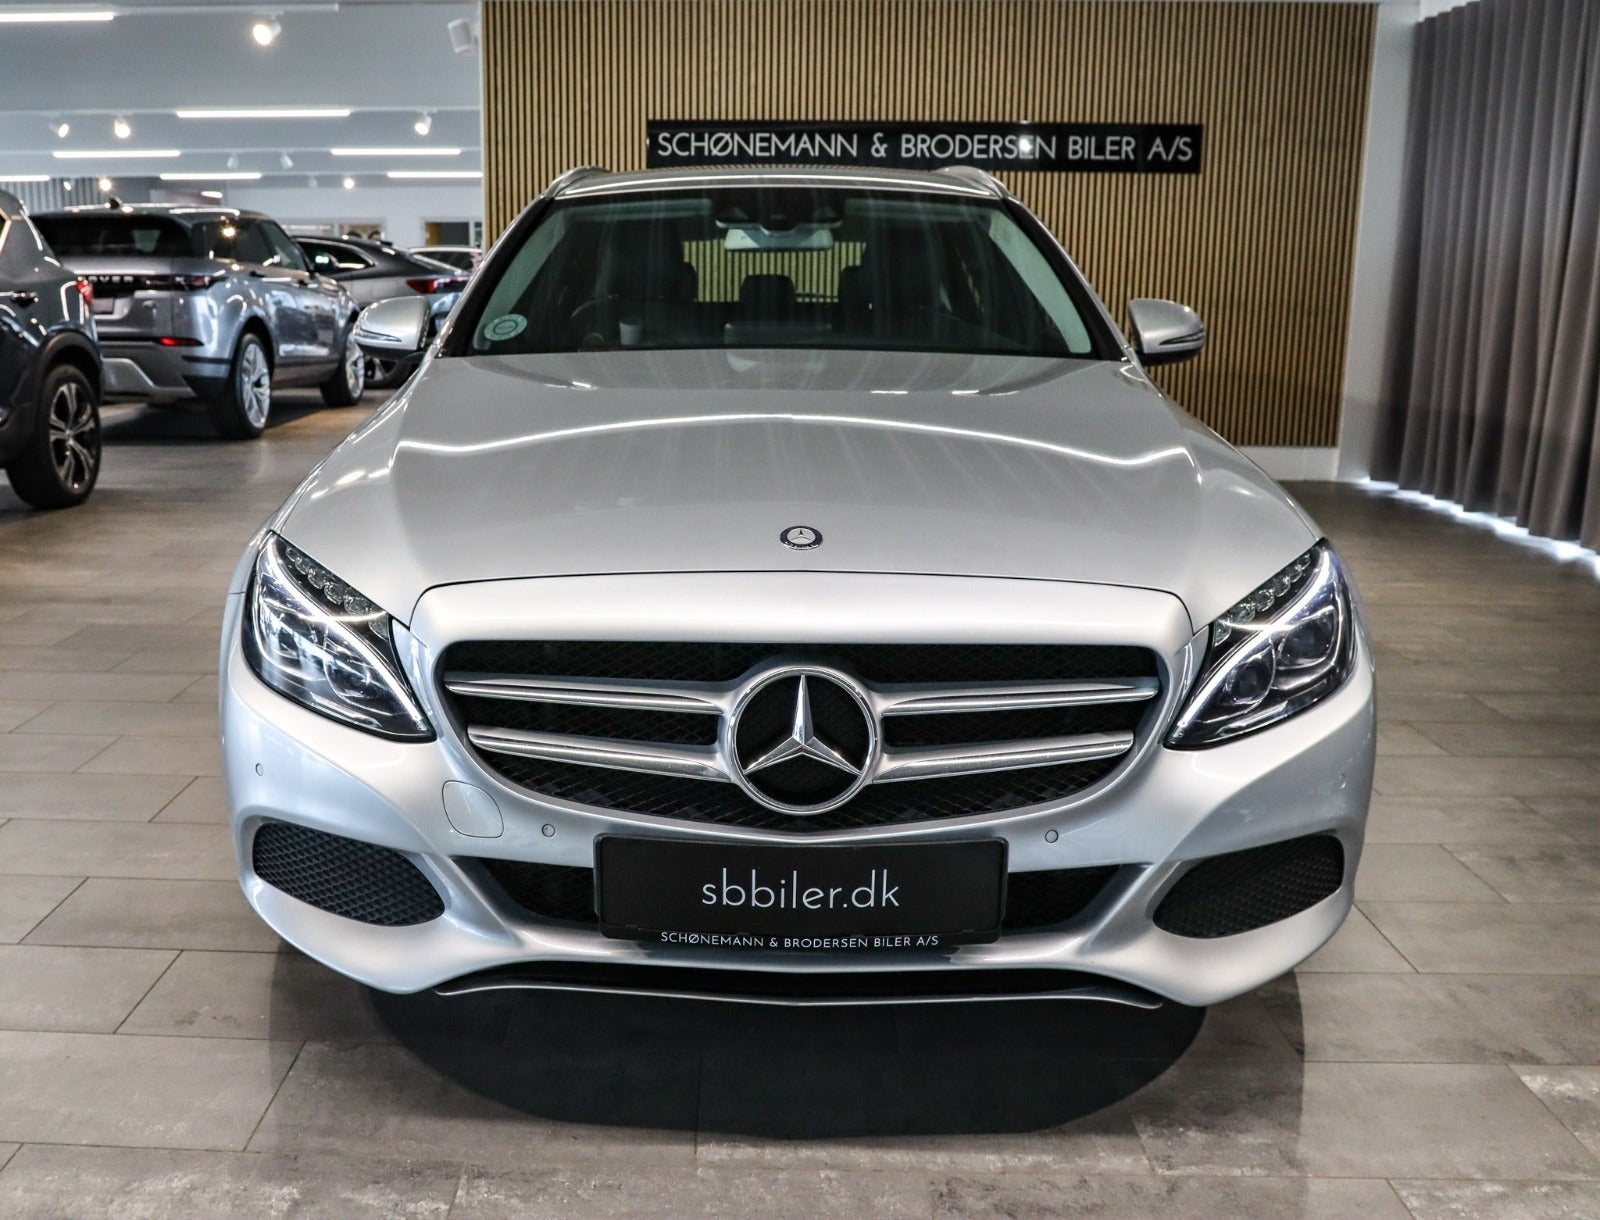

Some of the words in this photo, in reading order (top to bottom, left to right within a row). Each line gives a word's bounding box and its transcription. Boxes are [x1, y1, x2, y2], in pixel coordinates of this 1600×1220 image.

[657, 132, 858, 157] SCHØNEMANN
[870, 132, 888, 158] &
[900, 133, 1056, 160] BRODERSEN
[1068, 135, 1136, 161] BILER
[1147, 136, 1193, 162] A/S
[701, 867, 900, 910] sbbiler.dk
[660, 931, 764, 947] SCHØNEMANN
[769, 937, 778, 948] &
[784, 938, 868, 948] BRODERSEN
[873, 936, 911, 948] BILER
[916, 935, 939, 947] A/S
